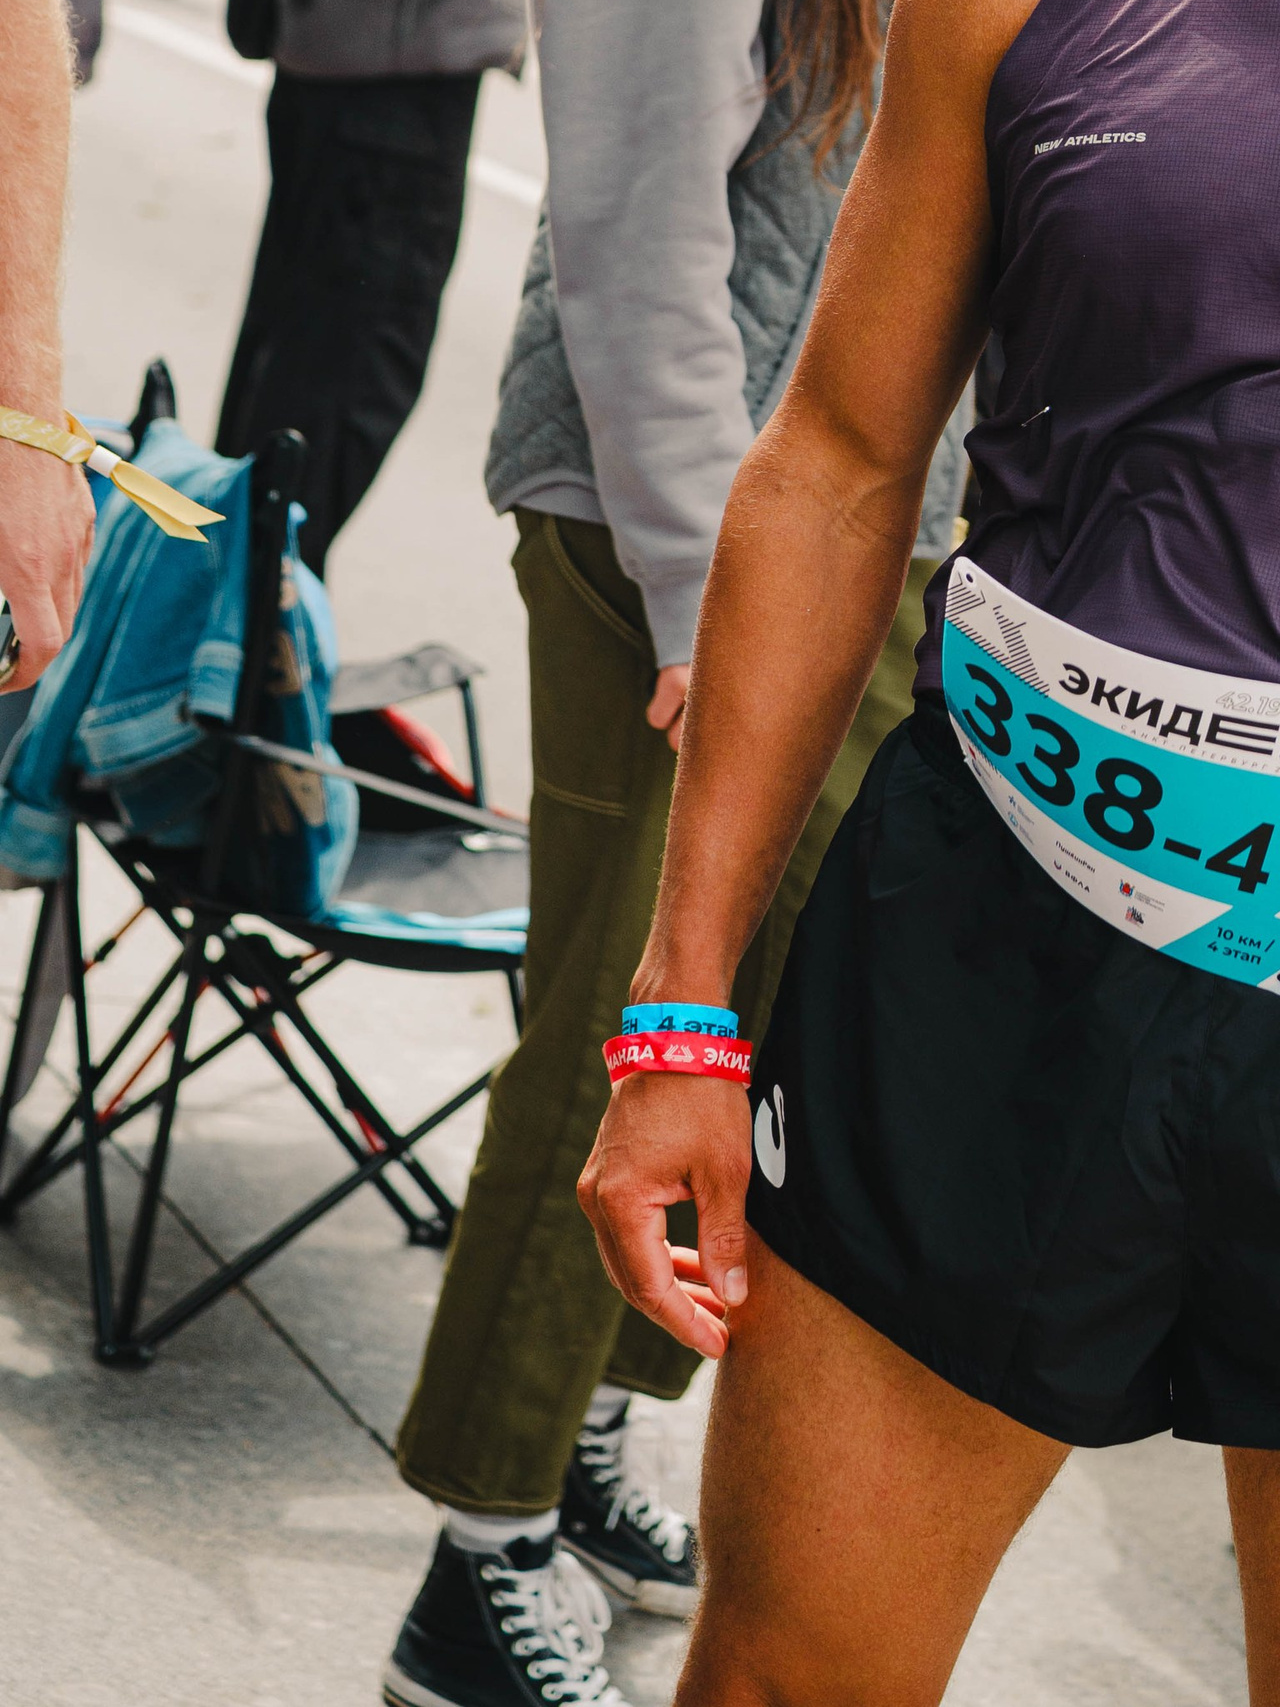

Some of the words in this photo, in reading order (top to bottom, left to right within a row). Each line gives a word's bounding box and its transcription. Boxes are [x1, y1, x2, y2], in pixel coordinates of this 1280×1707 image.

[1034, 137, 1063, 155] NEW
[1063, 131, 1147, 147] ATHLETICS
[961, 662, 1275, 895] 338-4
[1216, 926, 1235, 941] 10
[1206, 940, 1219, 953] 4
[1222, 946, 1262, 966] этап
[656, 1015, 677, 1032] 4
